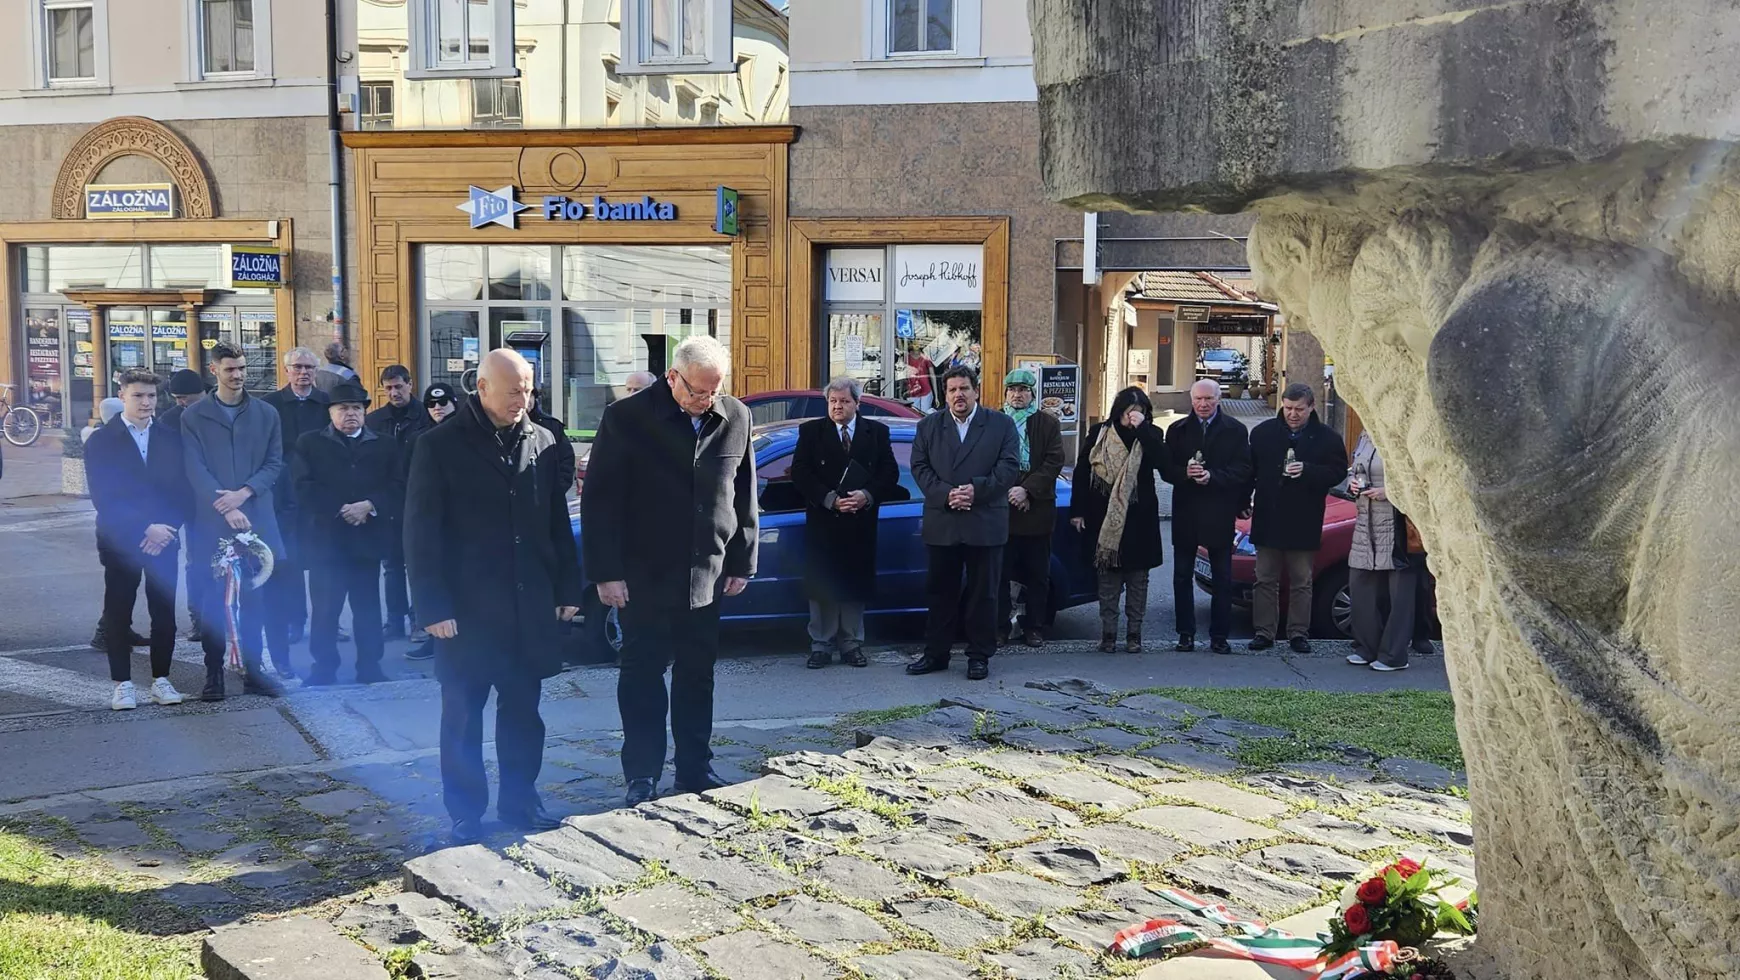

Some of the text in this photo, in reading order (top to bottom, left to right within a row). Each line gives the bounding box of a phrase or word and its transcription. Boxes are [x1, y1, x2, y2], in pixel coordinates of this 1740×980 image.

[89, 189, 168, 207] ZÁLOŽŇA
[478, 194, 505, 219] Fio
[543, 195, 674, 220] Fio banka
[233, 254, 279, 272] ZÁLOŽŇA
[237, 272, 276, 281] ZÁLOGHÁZ
[829, 267, 882, 283] VERSAI
[900, 261, 977, 288] Joseph Ribkoff
[110, 325, 144, 334] ZÁLOŽŇA
[153, 325, 187, 335] ZÁLOŽŇA
